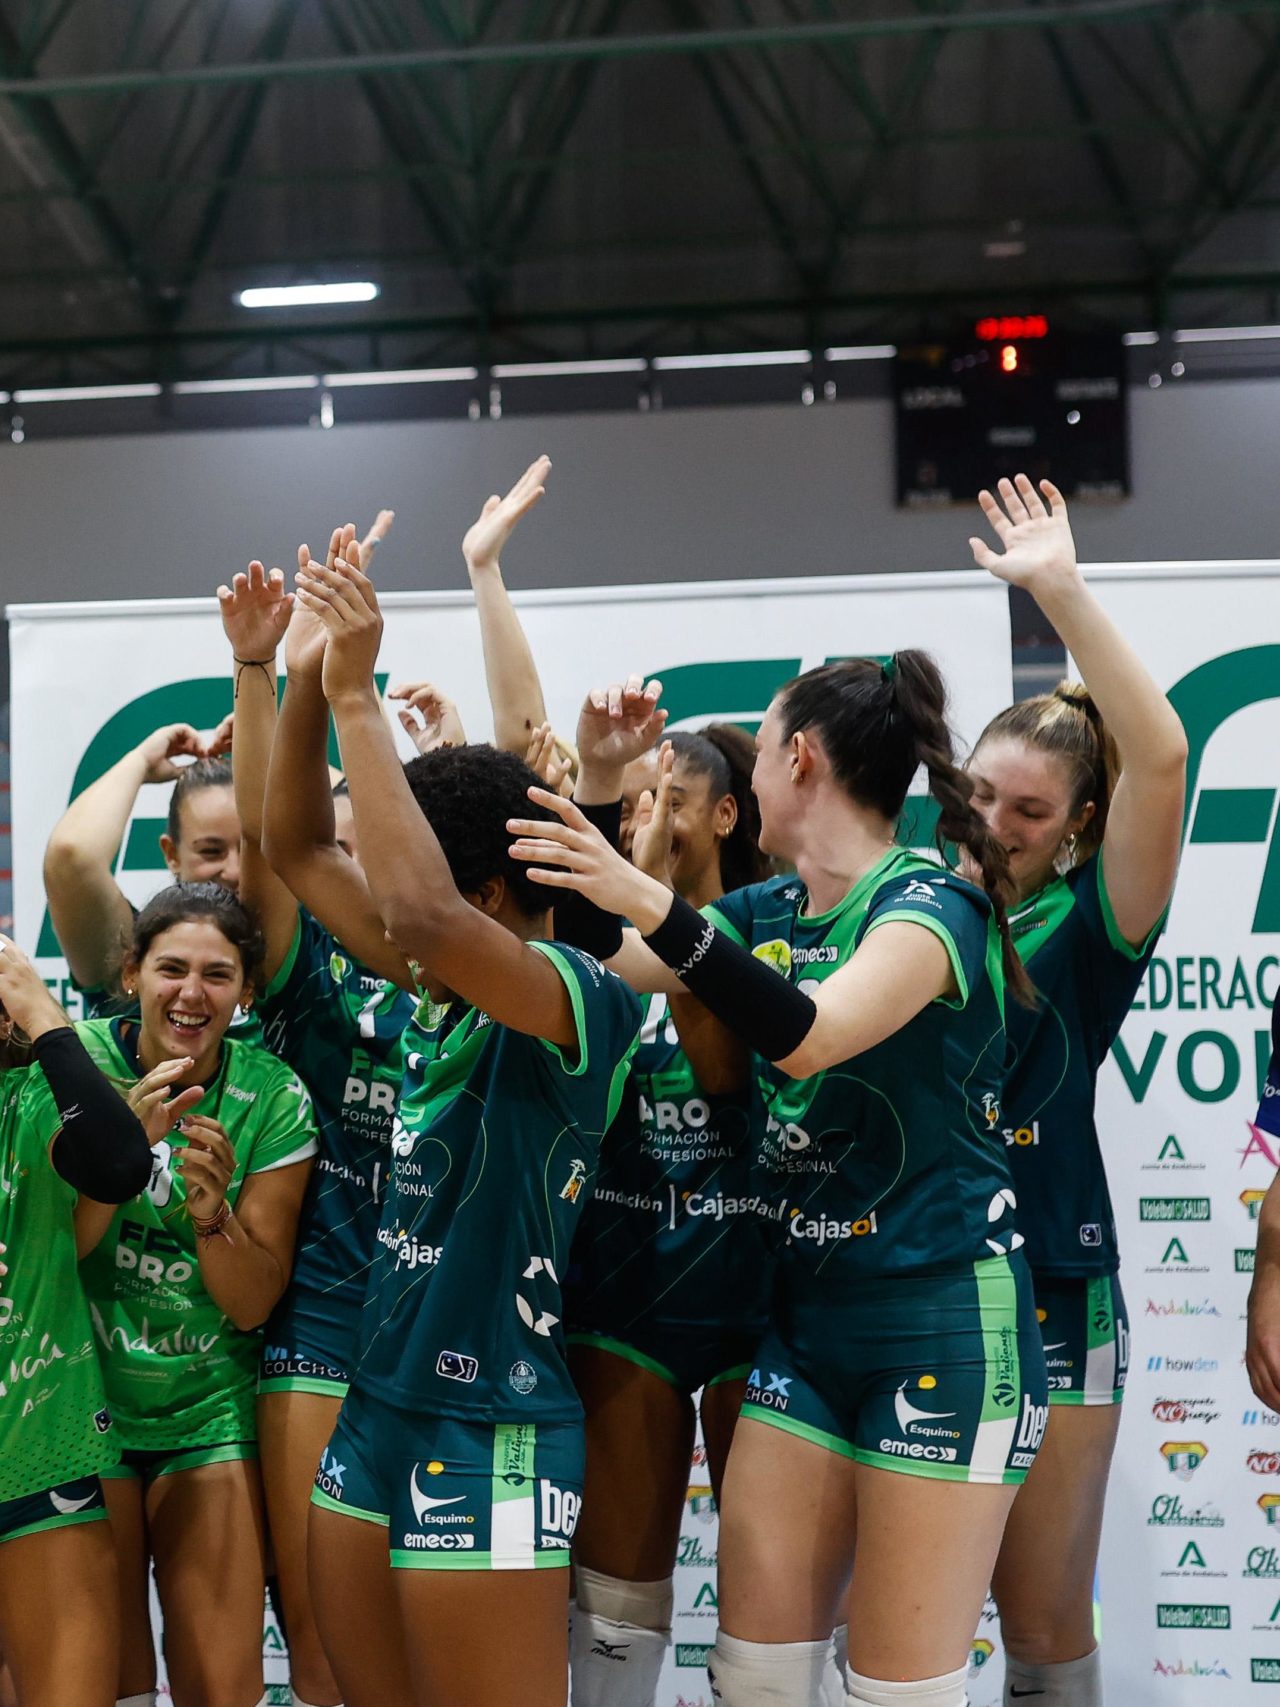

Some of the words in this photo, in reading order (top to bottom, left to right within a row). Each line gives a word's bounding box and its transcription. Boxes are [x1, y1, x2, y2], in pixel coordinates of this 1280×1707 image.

[791, 946, 827, 965] emec
[789, 1210, 878, 1246] Cajasol
[115, 1244, 193, 1285] PRO
[1165, 1356, 1218, 1372] howden
[909, 1423, 960, 1438] Esquimo
[879, 1438, 939, 1460] emec
[424, 1513, 475, 1526] Esquimo
[404, 1532, 455, 1549] emec
